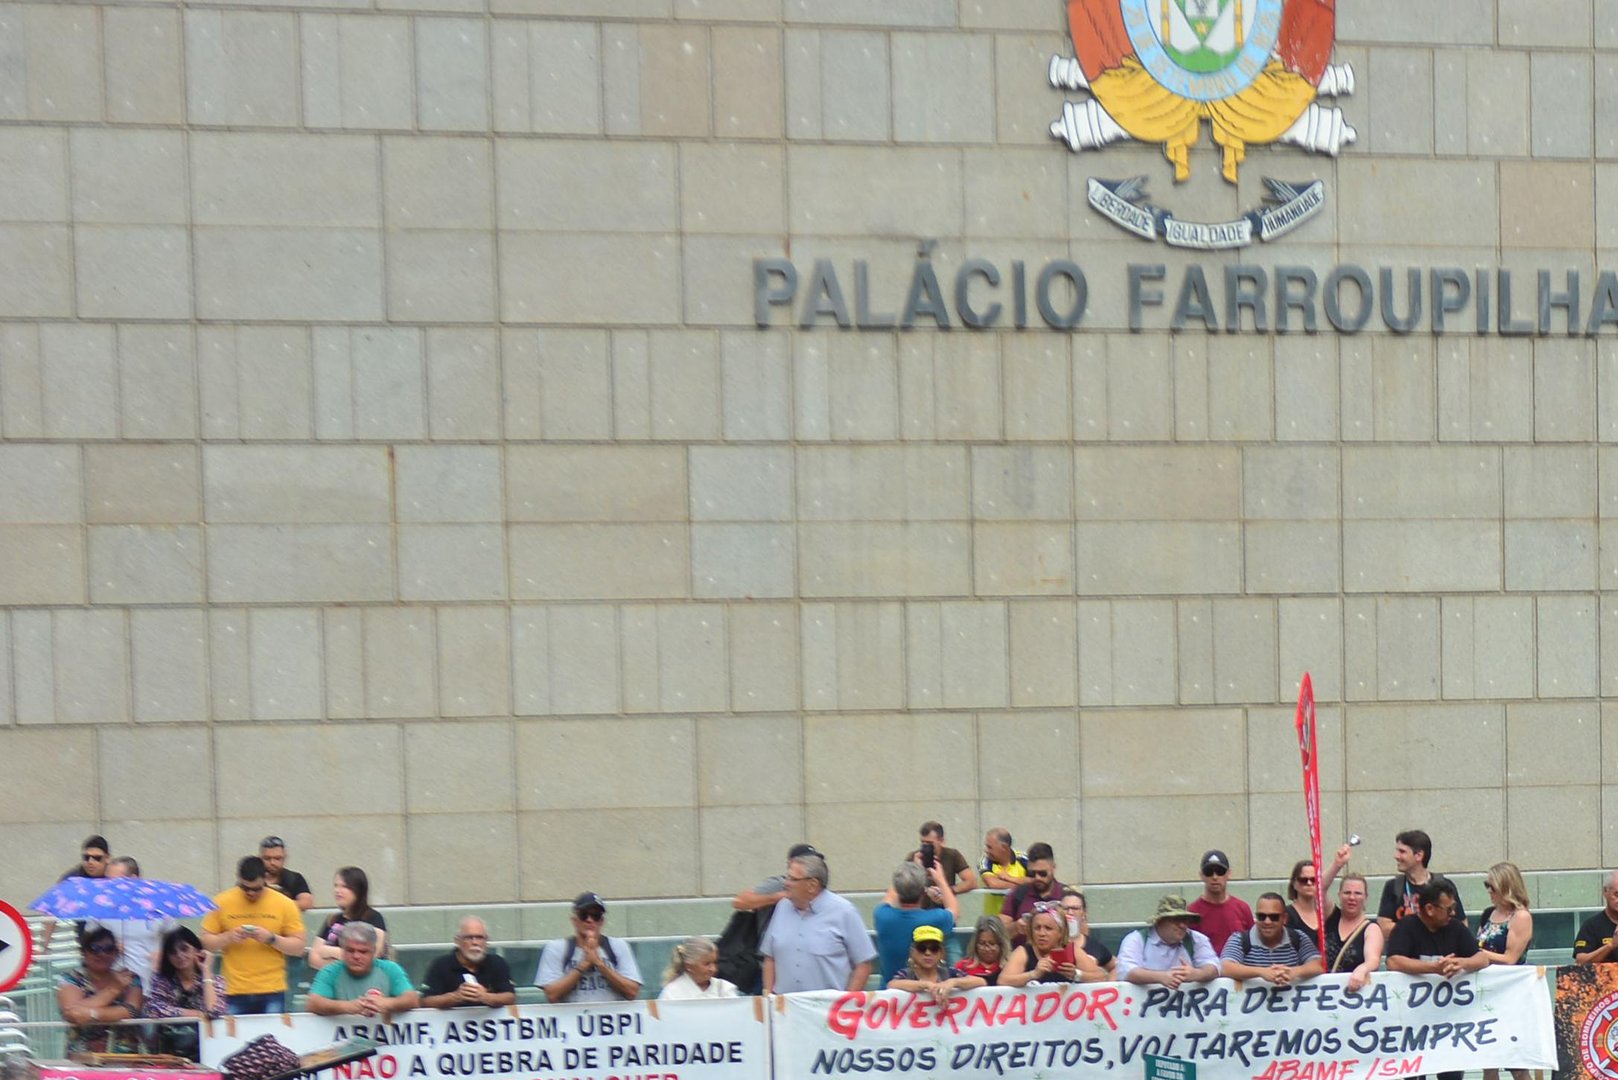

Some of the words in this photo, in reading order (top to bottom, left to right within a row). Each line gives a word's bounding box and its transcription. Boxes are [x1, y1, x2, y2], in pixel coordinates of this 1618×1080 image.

[1264, 187, 1322, 233] HUMANIDADE
[1167, 222, 1244, 243] IGUALDADE
[752, 240, 1088, 331] PALÁCIO
[443, 1015, 568, 1046] ASSTBM,
[577, 1007, 643, 1038] ÚBPI
[827, 986, 1132, 1040] GOVERNADOR:
[1141, 986, 1227, 1019] PARA
[1240, 981, 1389, 1015] DEFESA
[1406, 977, 1476, 1009] DOS
[1581, 997, 1611, 1047] BOMBEIROS
[408, 1054, 428, 1077] A
[439, 1047, 552, 1077] QUEBRA
[562, 1047, 598, 1071] DE
[607, 1041, 744, 1069] PARIDADE
[811, 1047, 937, 1076] NOSSOS
